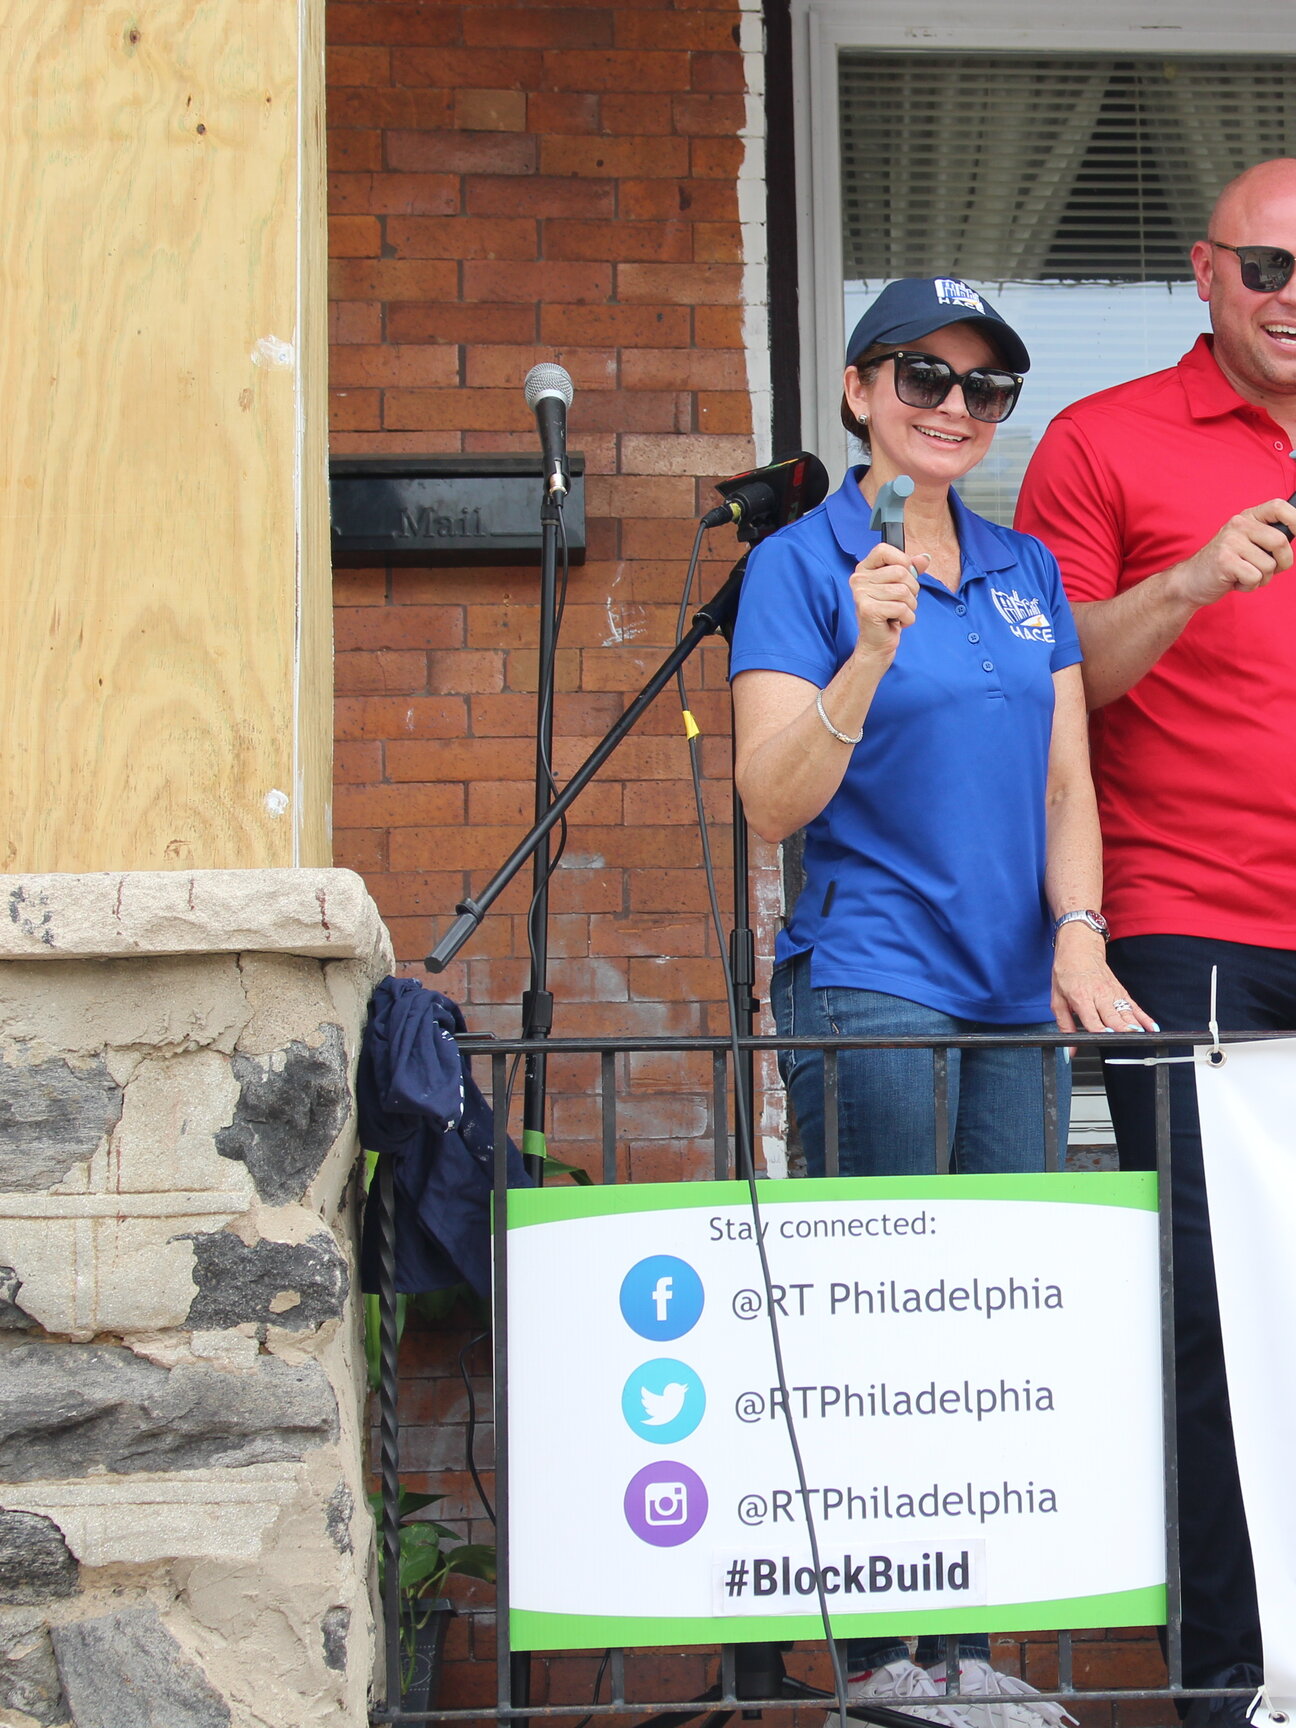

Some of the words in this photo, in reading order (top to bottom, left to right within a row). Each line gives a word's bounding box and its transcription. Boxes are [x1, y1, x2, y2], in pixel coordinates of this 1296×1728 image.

[398, 506, 487, 538] Mail
[1009, 625, 1057, 643] HACE
[709, 1215, 769, 1246] Stay
[779, 1210, 937, 1240] connected:
[732, 1283, 814, 1321] @RT
[830, 1277, 1064, 1319] Philadelphia
[735, 1379, 1056, 1424] @RTPhiladelphia
[737, 1481, 1058, 1526] @RTPhiladelphia
[725, 1550, 971, 1598] #BlockBuild
